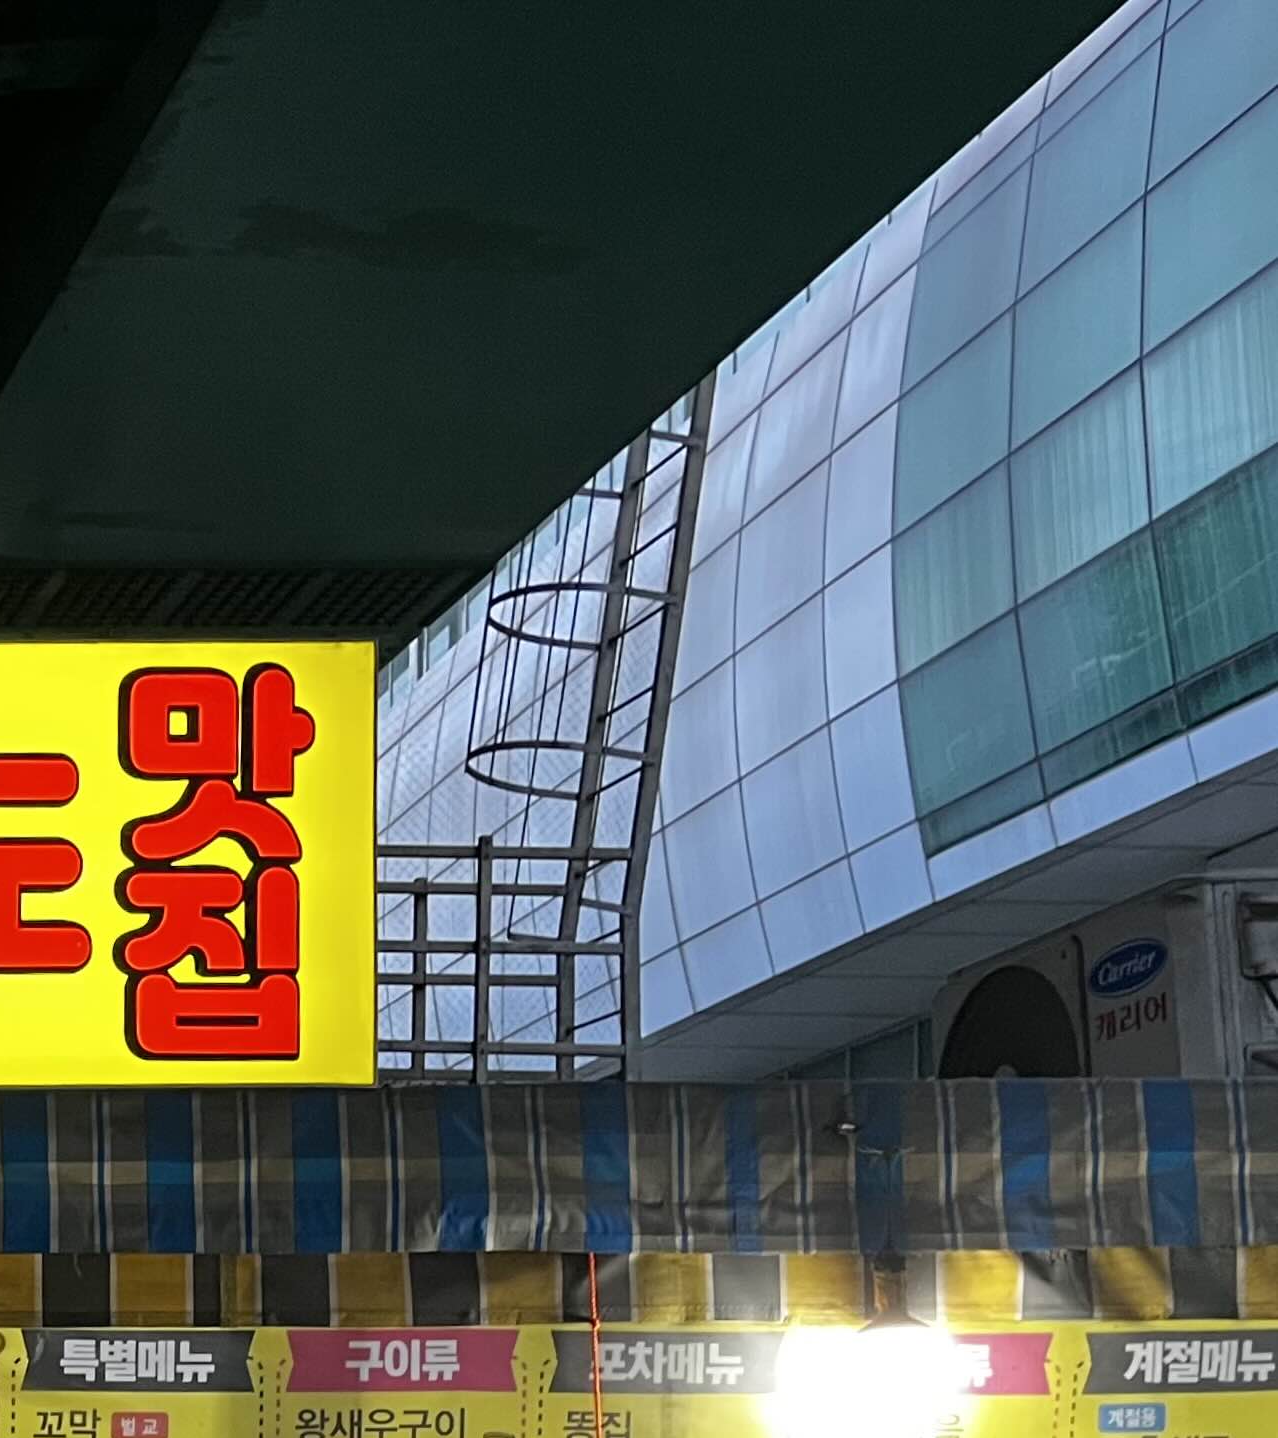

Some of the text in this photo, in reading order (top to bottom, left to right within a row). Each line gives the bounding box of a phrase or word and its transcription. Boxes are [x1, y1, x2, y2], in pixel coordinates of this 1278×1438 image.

[113, 662, 316, 1061] 맛집
[1097, 949, 1156, 987] Carrier
[1096, 992, 1167, 1041] 캐리어
[60, 1339, 215, 1382] 특별메뉴
[345, 1339, 460, 1382] 구이류
[589, 1339, 744, 1385] 포차메뉴
[1124, 1339, 1276, 1384] 계절메뉴
[120, 1415, 160, 1438] 벌교
[1107, 1406, 1157, 1429] 계절용
